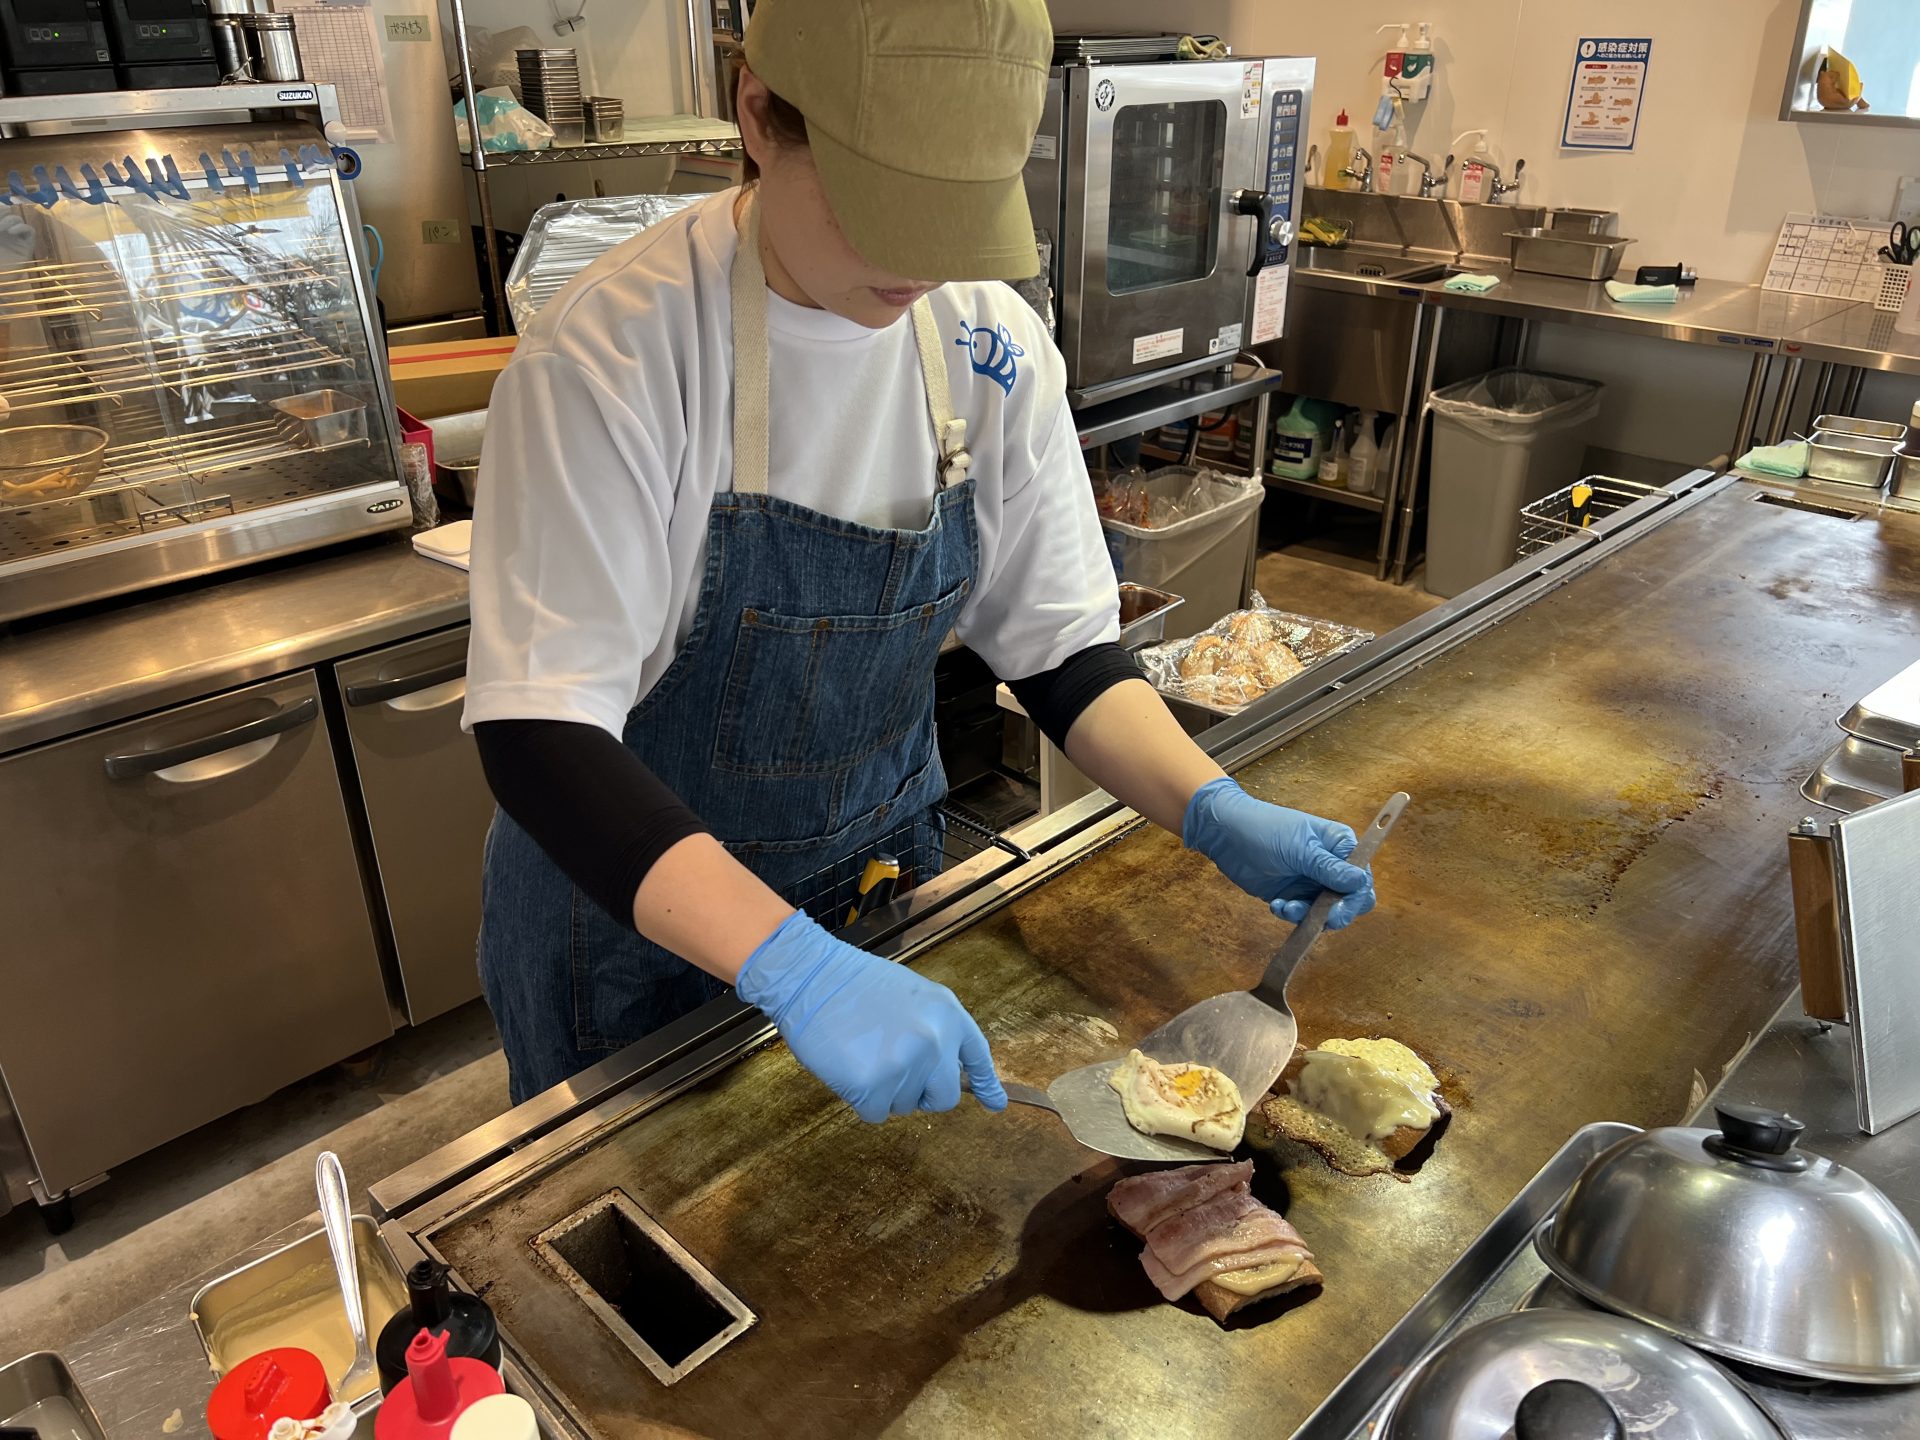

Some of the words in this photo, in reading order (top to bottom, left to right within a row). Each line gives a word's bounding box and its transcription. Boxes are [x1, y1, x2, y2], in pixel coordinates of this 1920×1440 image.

[1597, 42, 1648, 53] 感染症対策
[279, 91, 312, 100] SUZUKAN
[428, 226, 450, 241] パン
[369, 501, 400, 511] TAIJI
